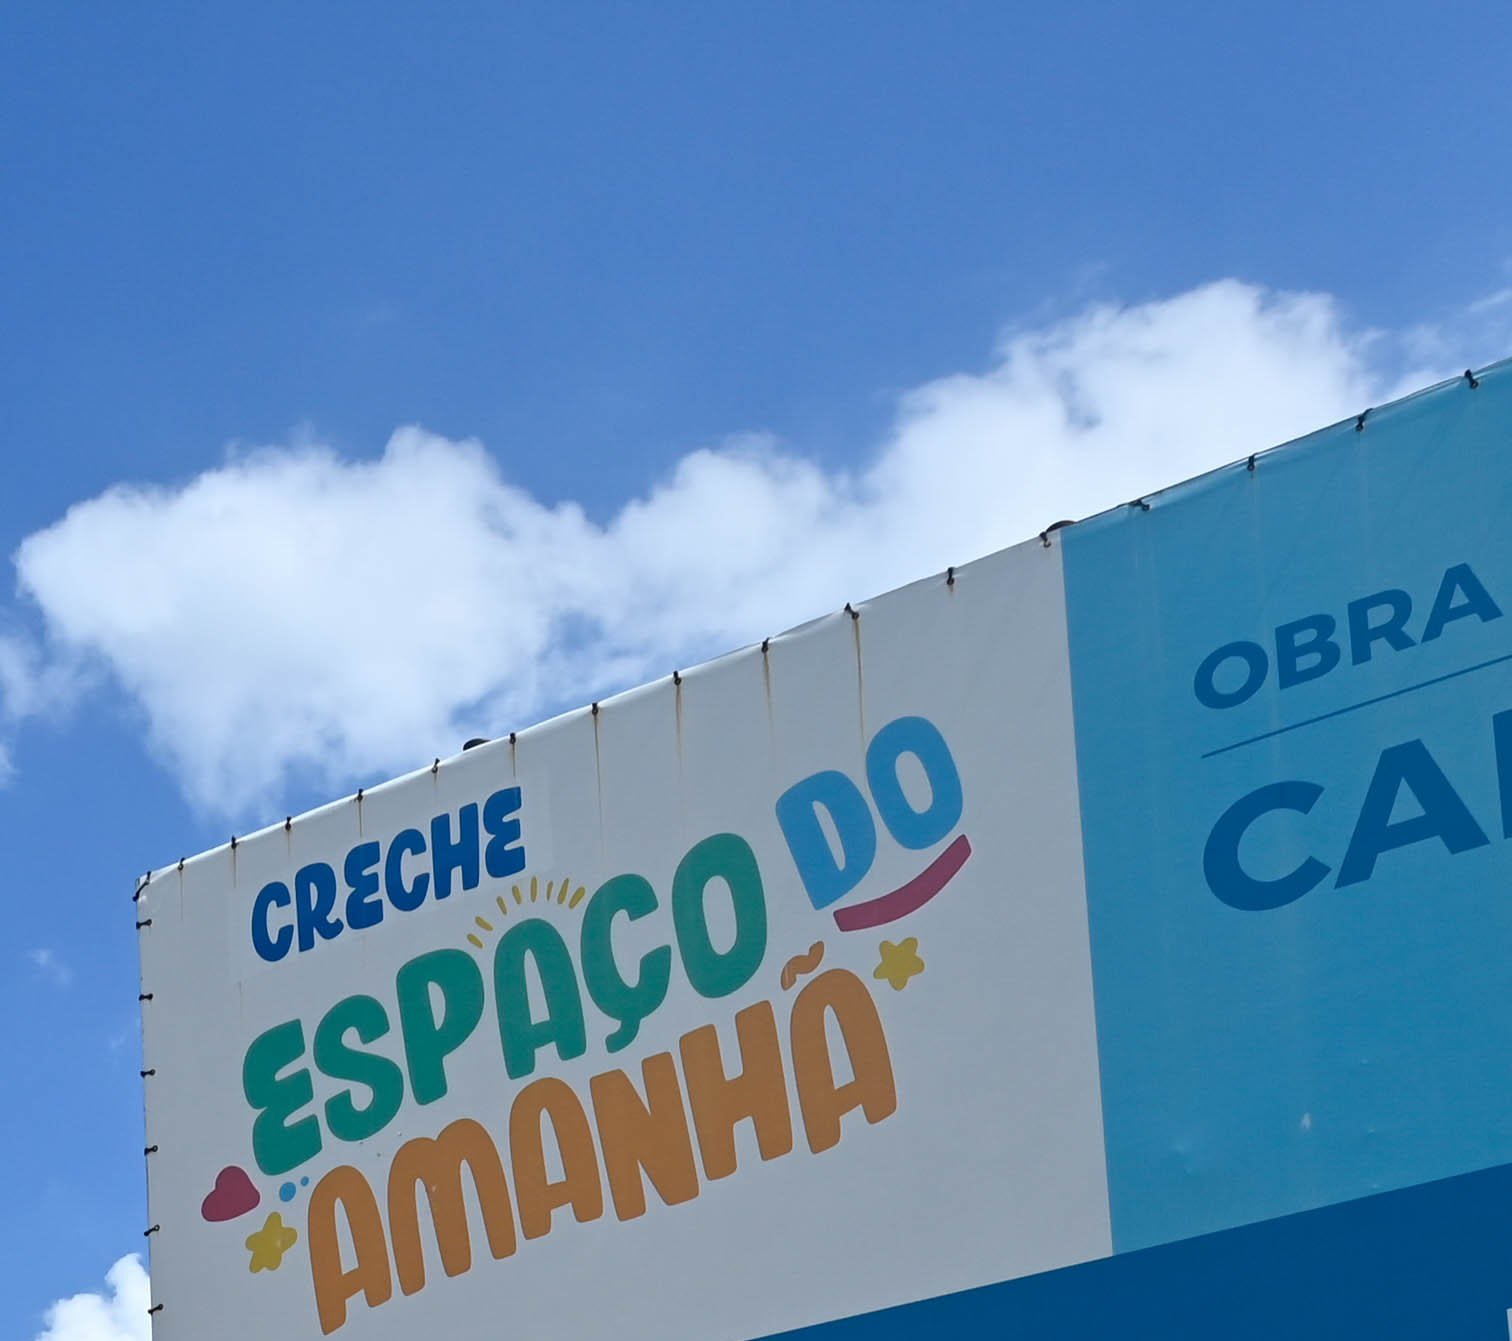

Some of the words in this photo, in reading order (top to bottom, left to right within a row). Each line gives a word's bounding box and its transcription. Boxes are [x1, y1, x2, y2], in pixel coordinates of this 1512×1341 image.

[1193, 562, 1504, 710] OBRA
[242, 832, 768, 1177] ESPAÇO
[775, 715, 964, 911] DO
[251, 786, 527, 963] CRECHE
[307, 942, 897, 1335] AMANHÃ
